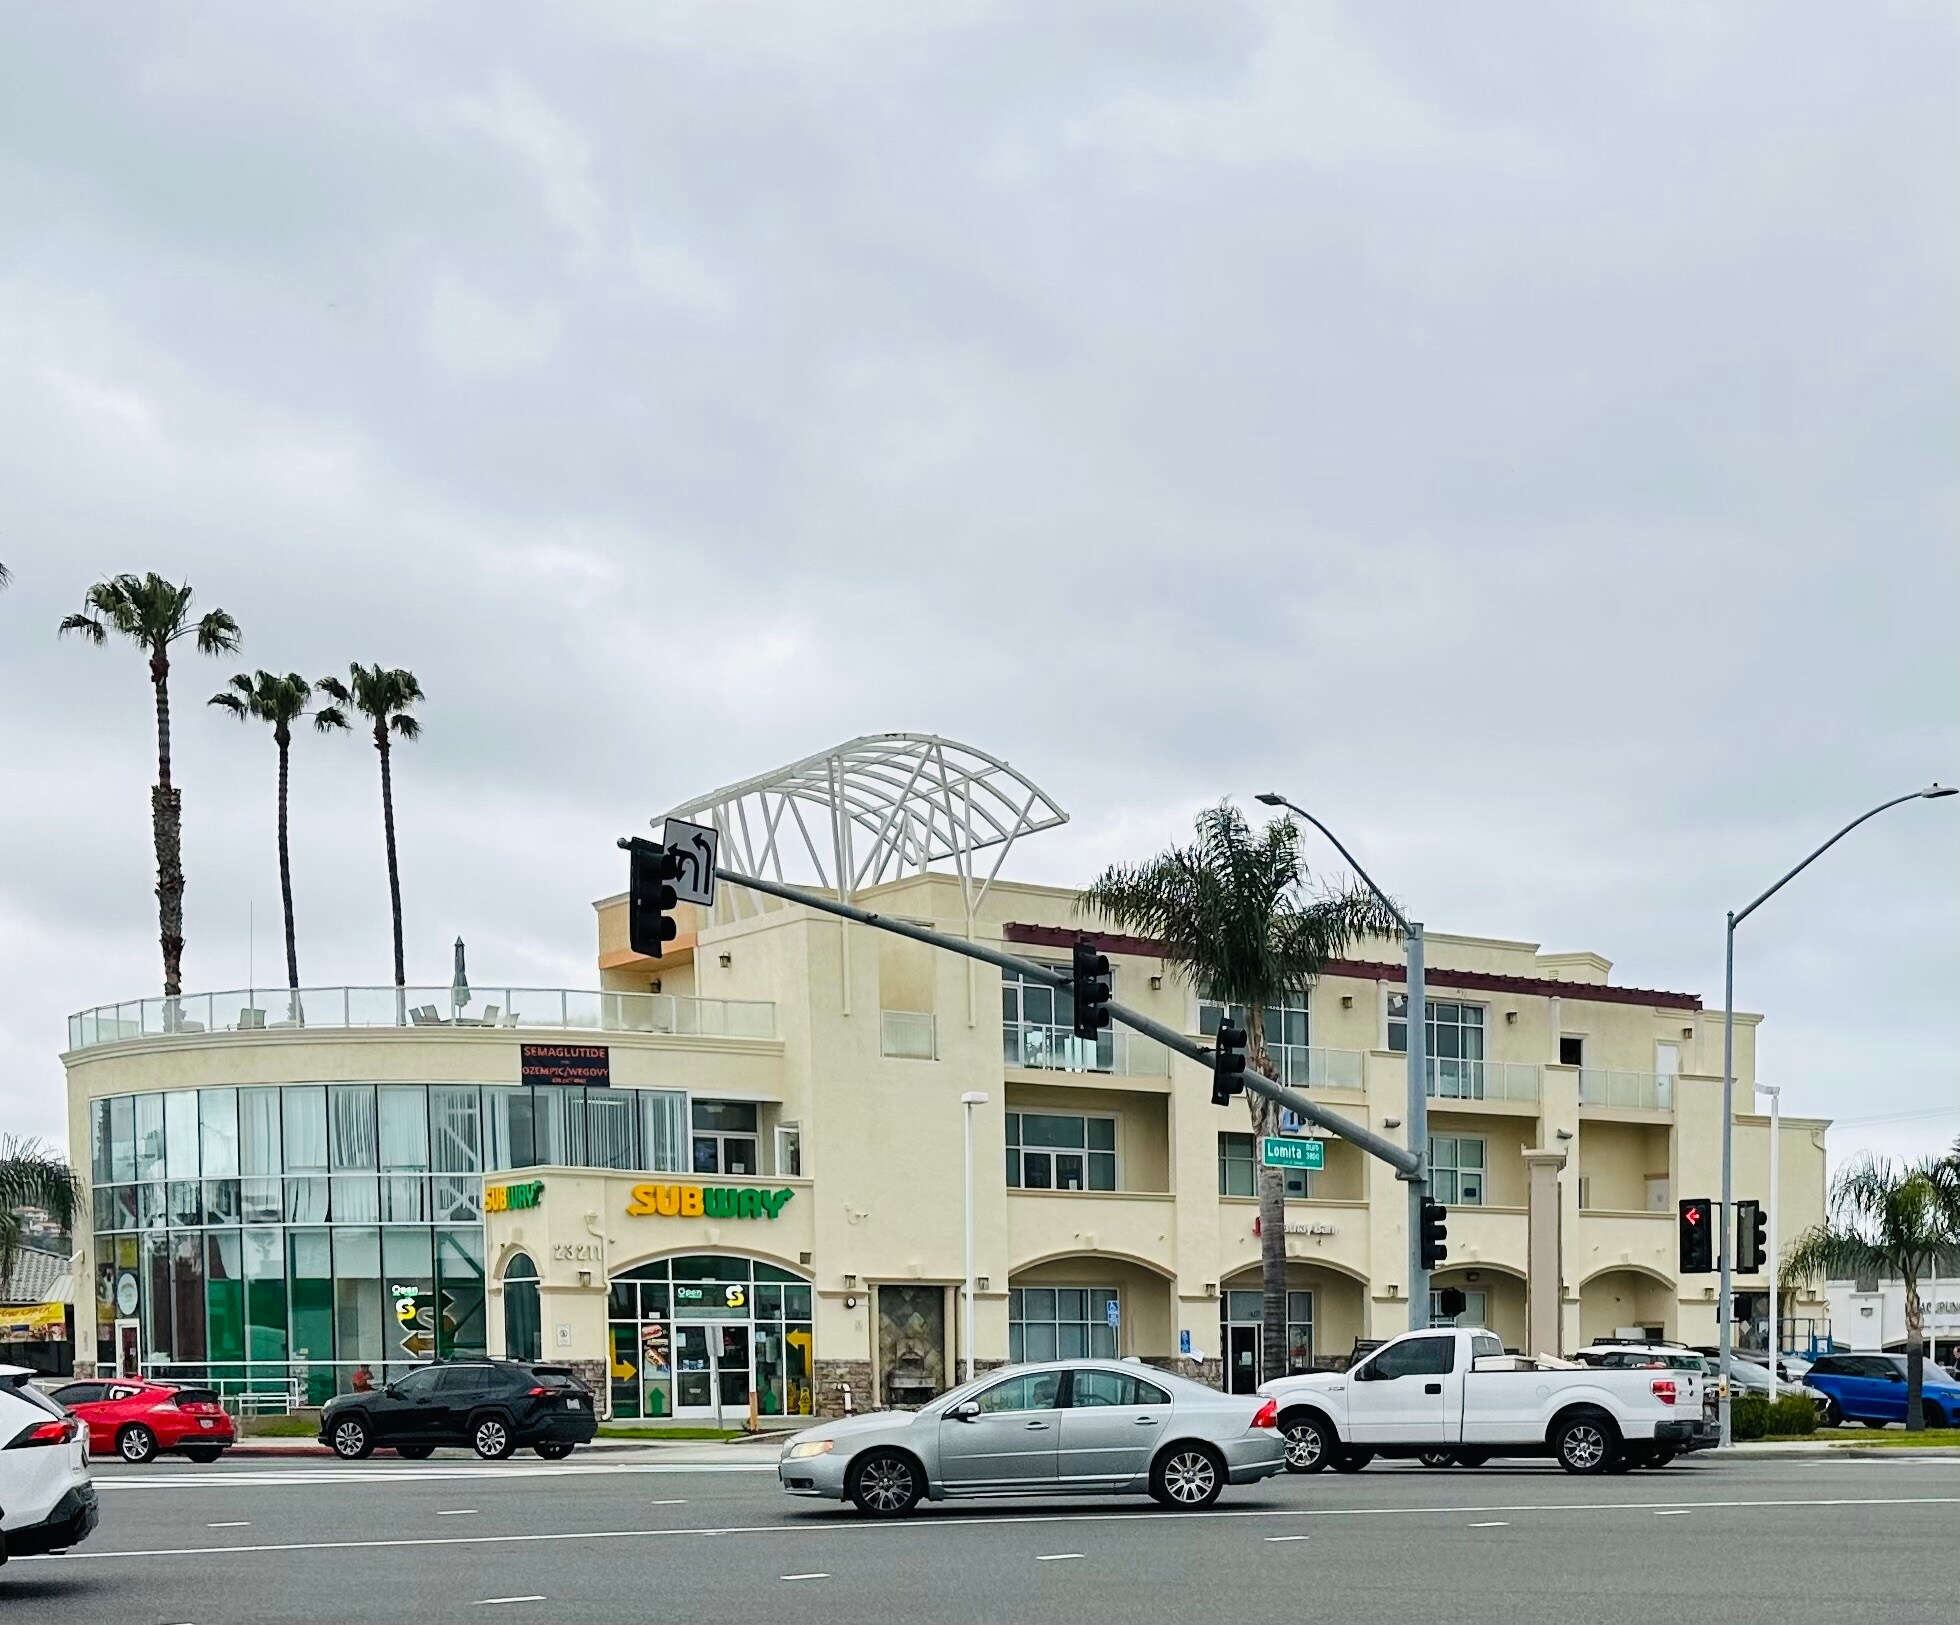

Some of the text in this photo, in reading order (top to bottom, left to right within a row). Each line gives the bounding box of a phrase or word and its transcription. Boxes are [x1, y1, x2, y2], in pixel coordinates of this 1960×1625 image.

[523, 1046, 606, 1058] SEMAGLUTIDE
[522, 1066, 609, 1077] OZEMPIC/WEGOVY
[1267, 1142, 1302, 1159] Lomita
[485, 1180, 545, 1212] SUBWAY
[626, 1184, 795, 1219] SUBWAY
[553, 1244, 602, 1261] 23211
[391, 1284, 419, 1297] Open
[677, 1287, 703, 1299] Open
